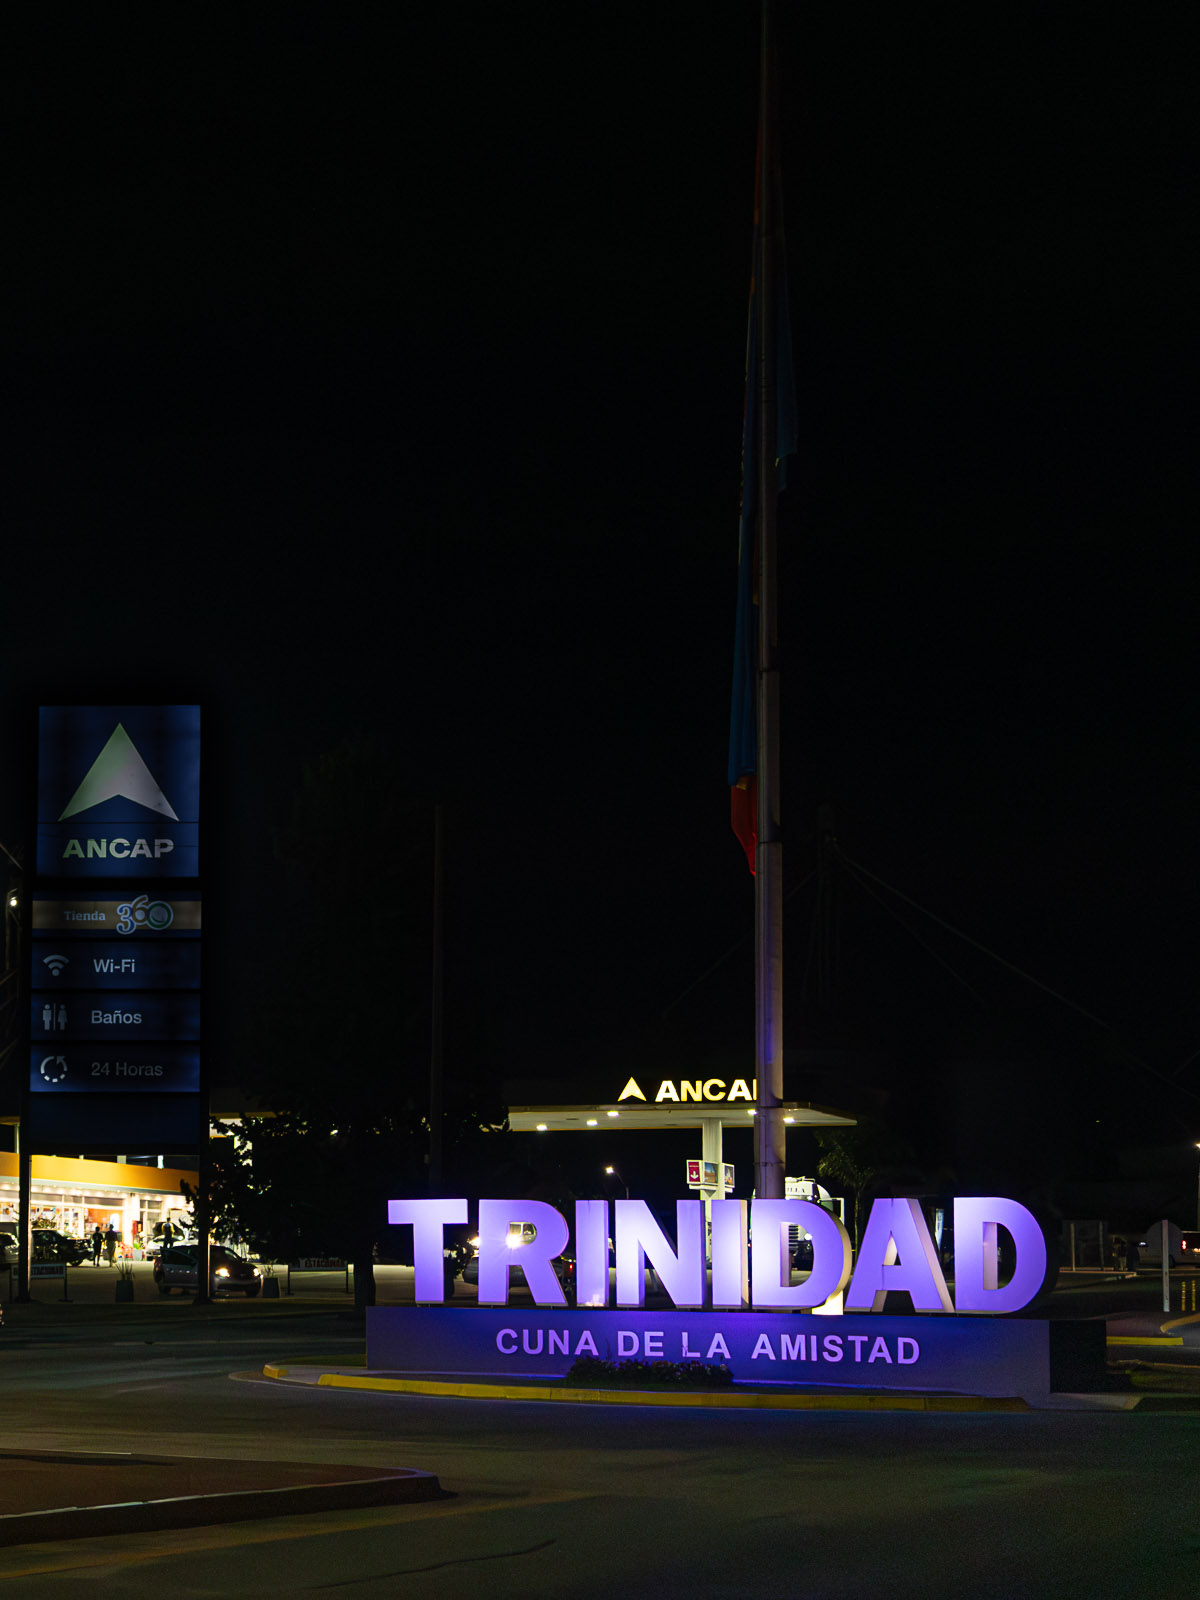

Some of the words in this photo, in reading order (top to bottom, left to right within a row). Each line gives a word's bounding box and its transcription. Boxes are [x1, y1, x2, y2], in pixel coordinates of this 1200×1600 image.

[62, 838, 175, 859] ANCAP
[63, 910, 106, 921] Tienda
[116, 894, 174, 935] 360
[92, 958, 136, 973] Wi-Fi
[91, 1009, 143, 1025] Baños
[90, 1062, 111, 1077] 24
[115, 1062, 164, 1077] Horas
[655, 1078, 757, 1102] ANCA
[387, 1196, 1048, 1315] TRINIDAD
[496, 1328, 599, 1356] CUNA
[617, 1331, 665, 1357] DE
[682, 1332, 731, 1359] LA
[751, 1333, 920, 1365] AMISTAD
